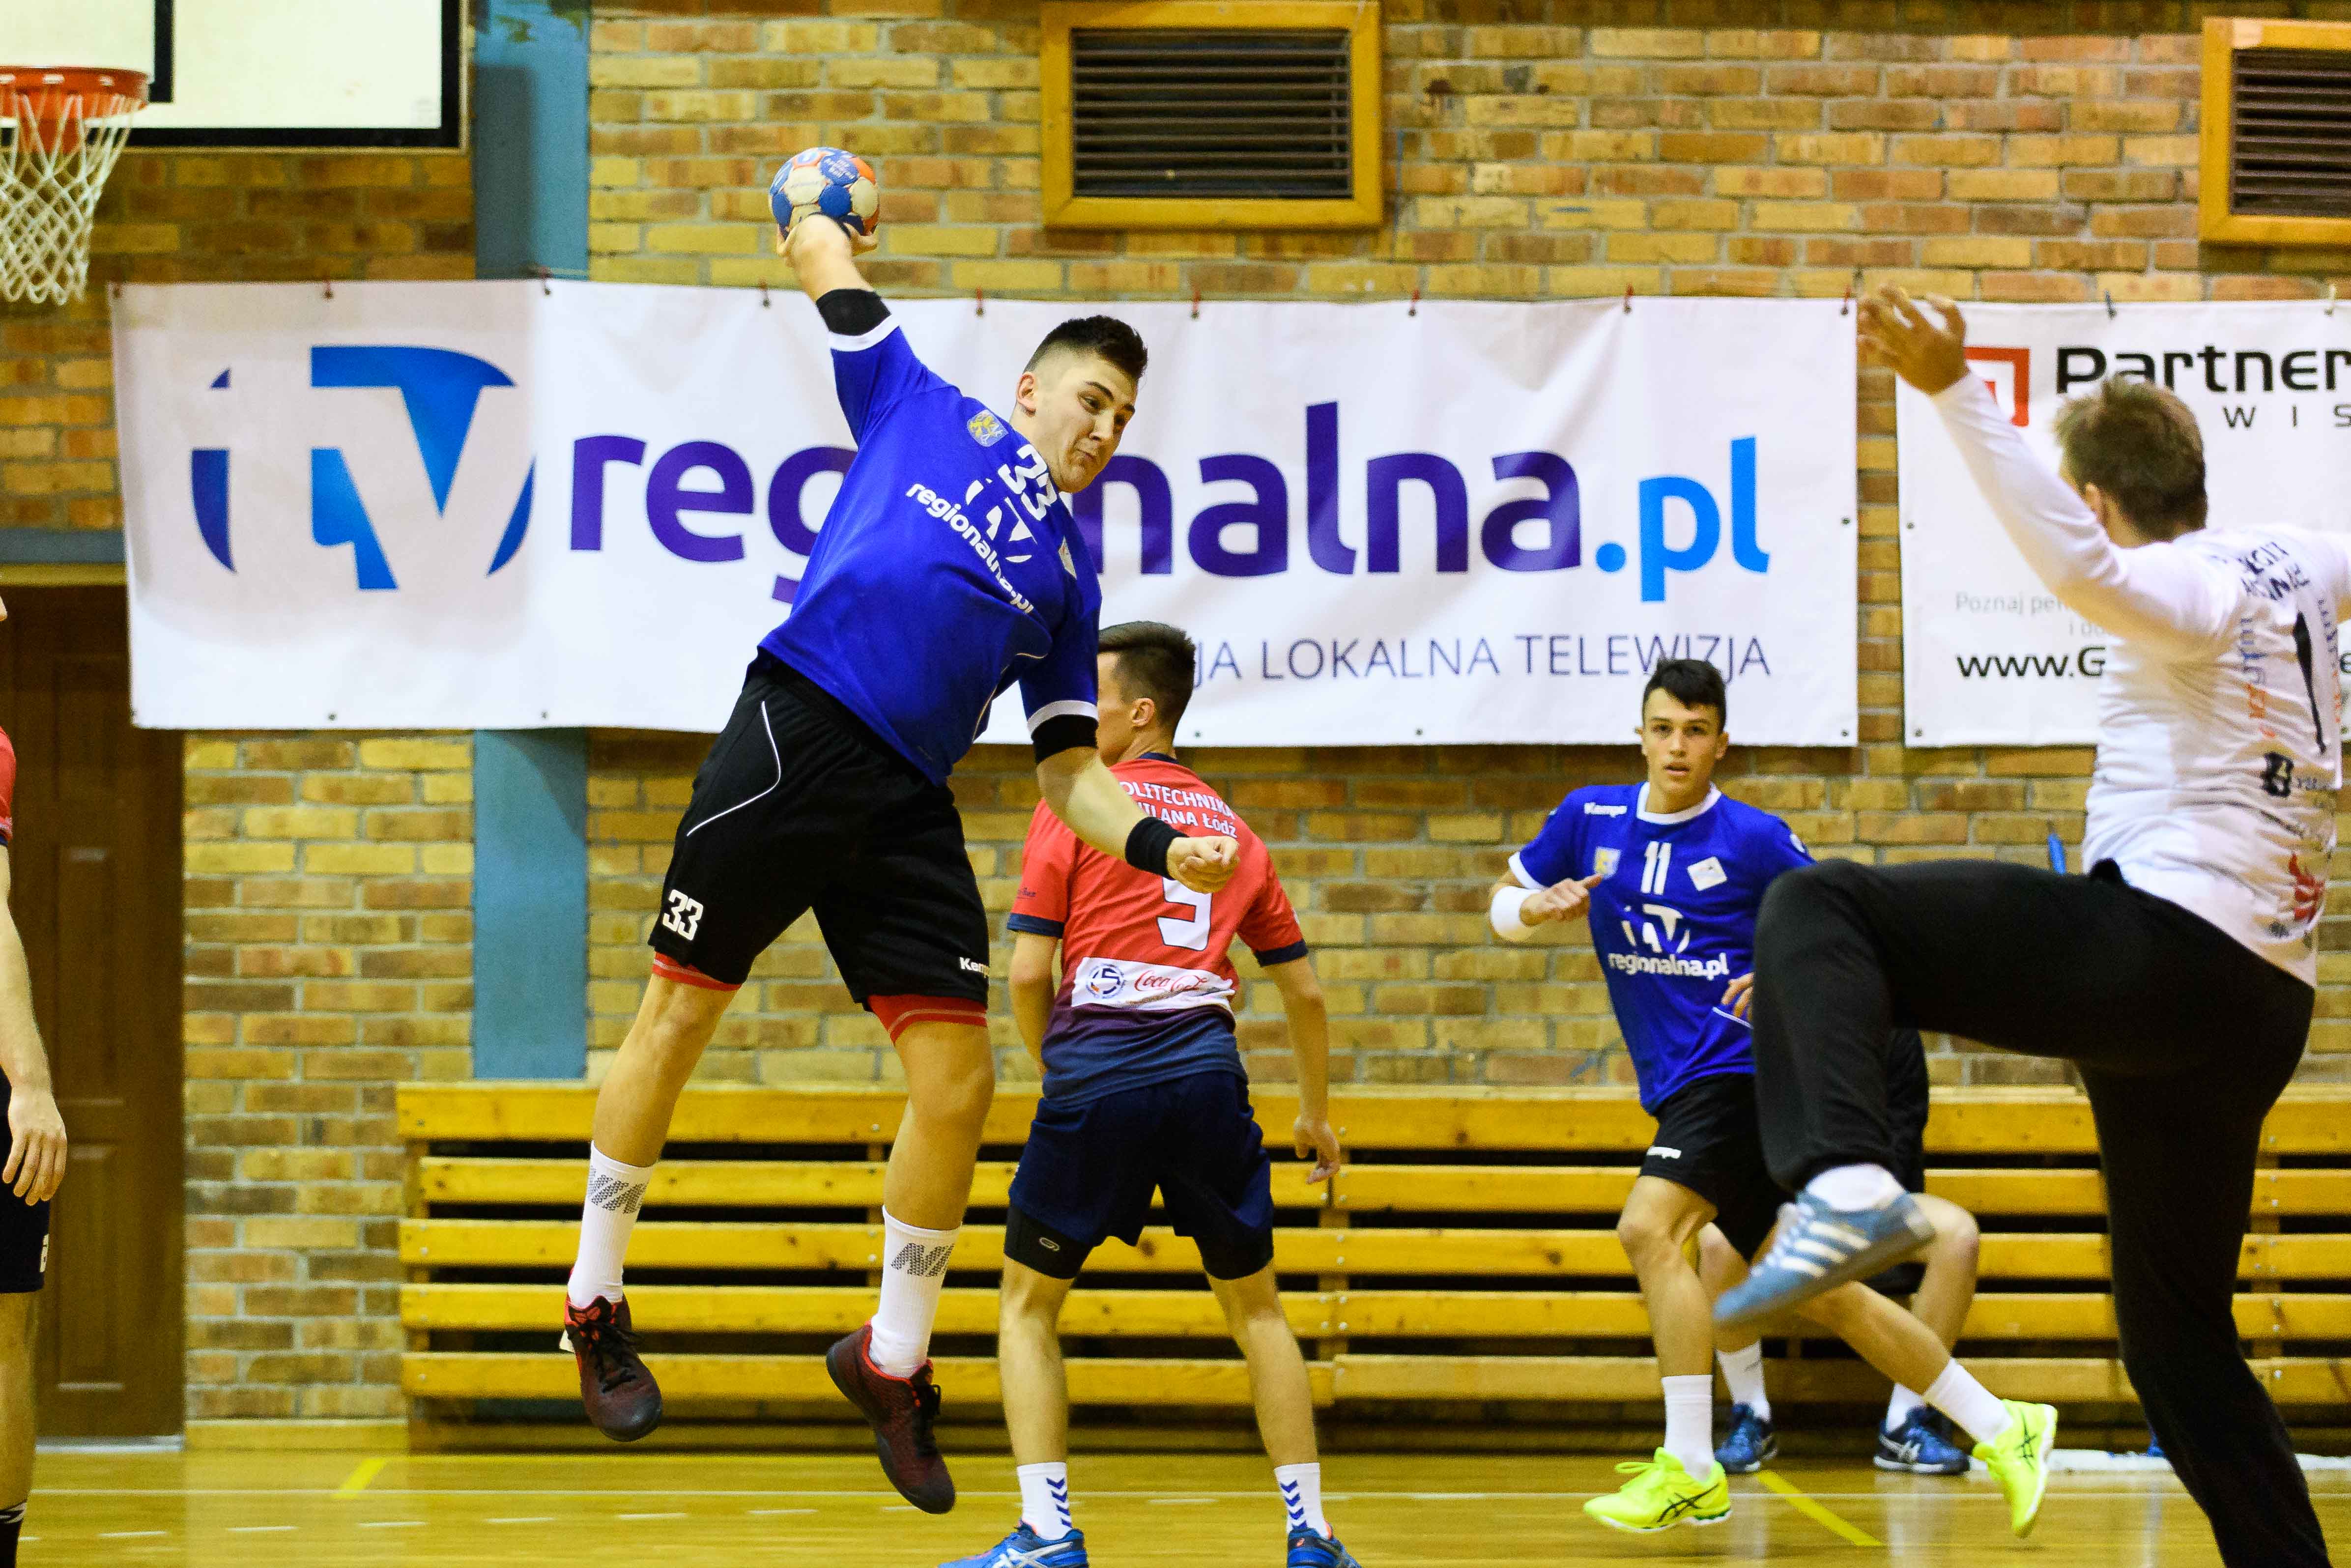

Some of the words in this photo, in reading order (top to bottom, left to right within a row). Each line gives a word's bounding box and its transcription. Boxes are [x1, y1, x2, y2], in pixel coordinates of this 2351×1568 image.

[570, 400, 1770, 605] regnalna.pl
[1262, 637, 1501, 680] LOKALNA
[1515, 634, 1771, 685] TELEWIZJA
[1956, 645, 2106, 678] www.G
[1119, 781, 1235, 820] OLITECHNIKA
[1640, 841, 1671, 896] 11
[662, 888, 704, 941] 33
[1608, 952, 1730, 981] regionalna.pl
